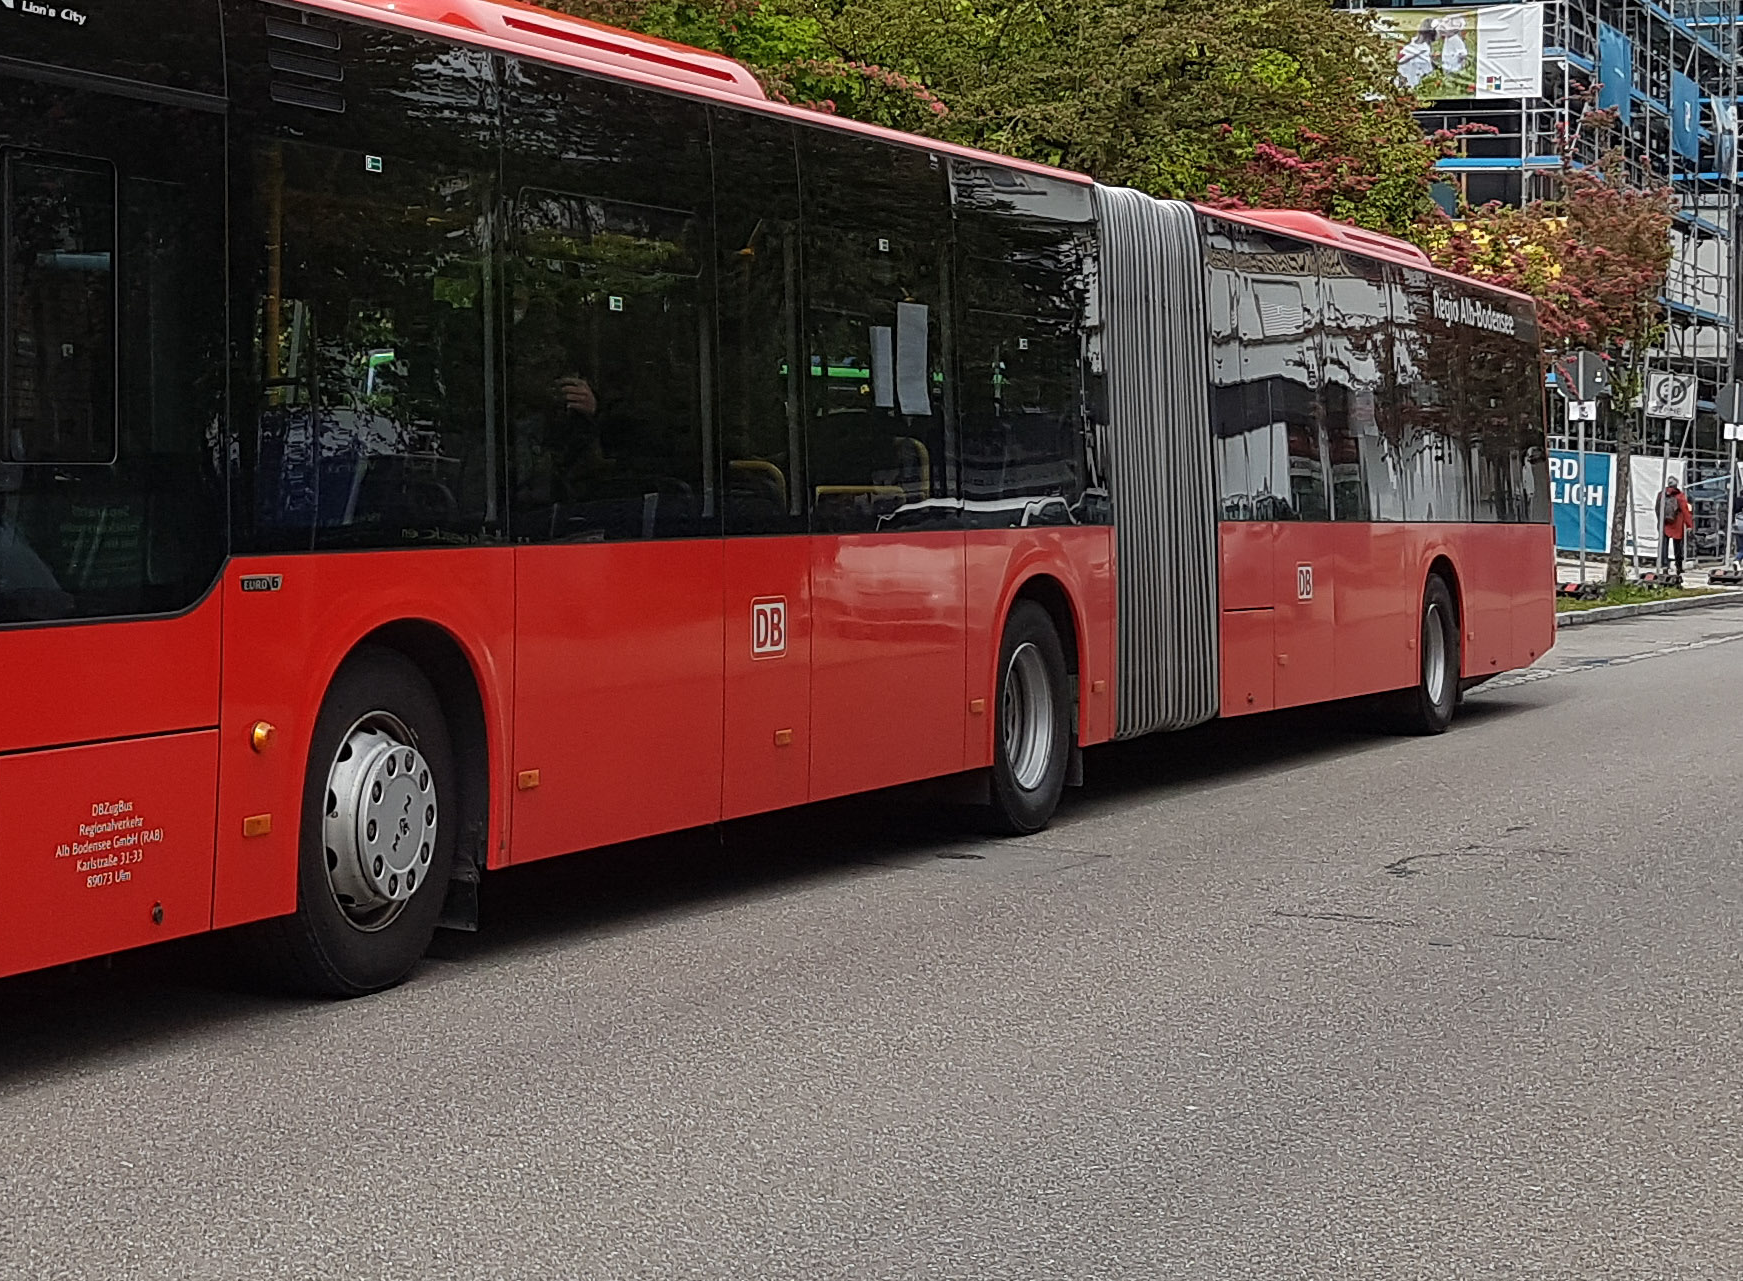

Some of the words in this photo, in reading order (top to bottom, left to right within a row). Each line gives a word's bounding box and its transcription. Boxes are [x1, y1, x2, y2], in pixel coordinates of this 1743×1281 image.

[22, 0, 56, 18] Lion's
[60, 8, 87, 26] City
[1432, 289, 1459, 328] Regio
[244, 579, 268, 590] EURO
[1299, 569, 1311, 596] DB
[756, 607, 782, 648] DB
[79, 815, 144, 837] Regionalverkehr
[55, 844, 71, 858] Alb
[72, 839, 111, 856] Bodensee
[113, 832, 138, 848] GmbH
[76, 853, 118, 872] Karlstraße
[119, 849, 143, 866] 31-33
[86, 871, 113, 888] 89073
[115, 869, 131, 883] Ulm
